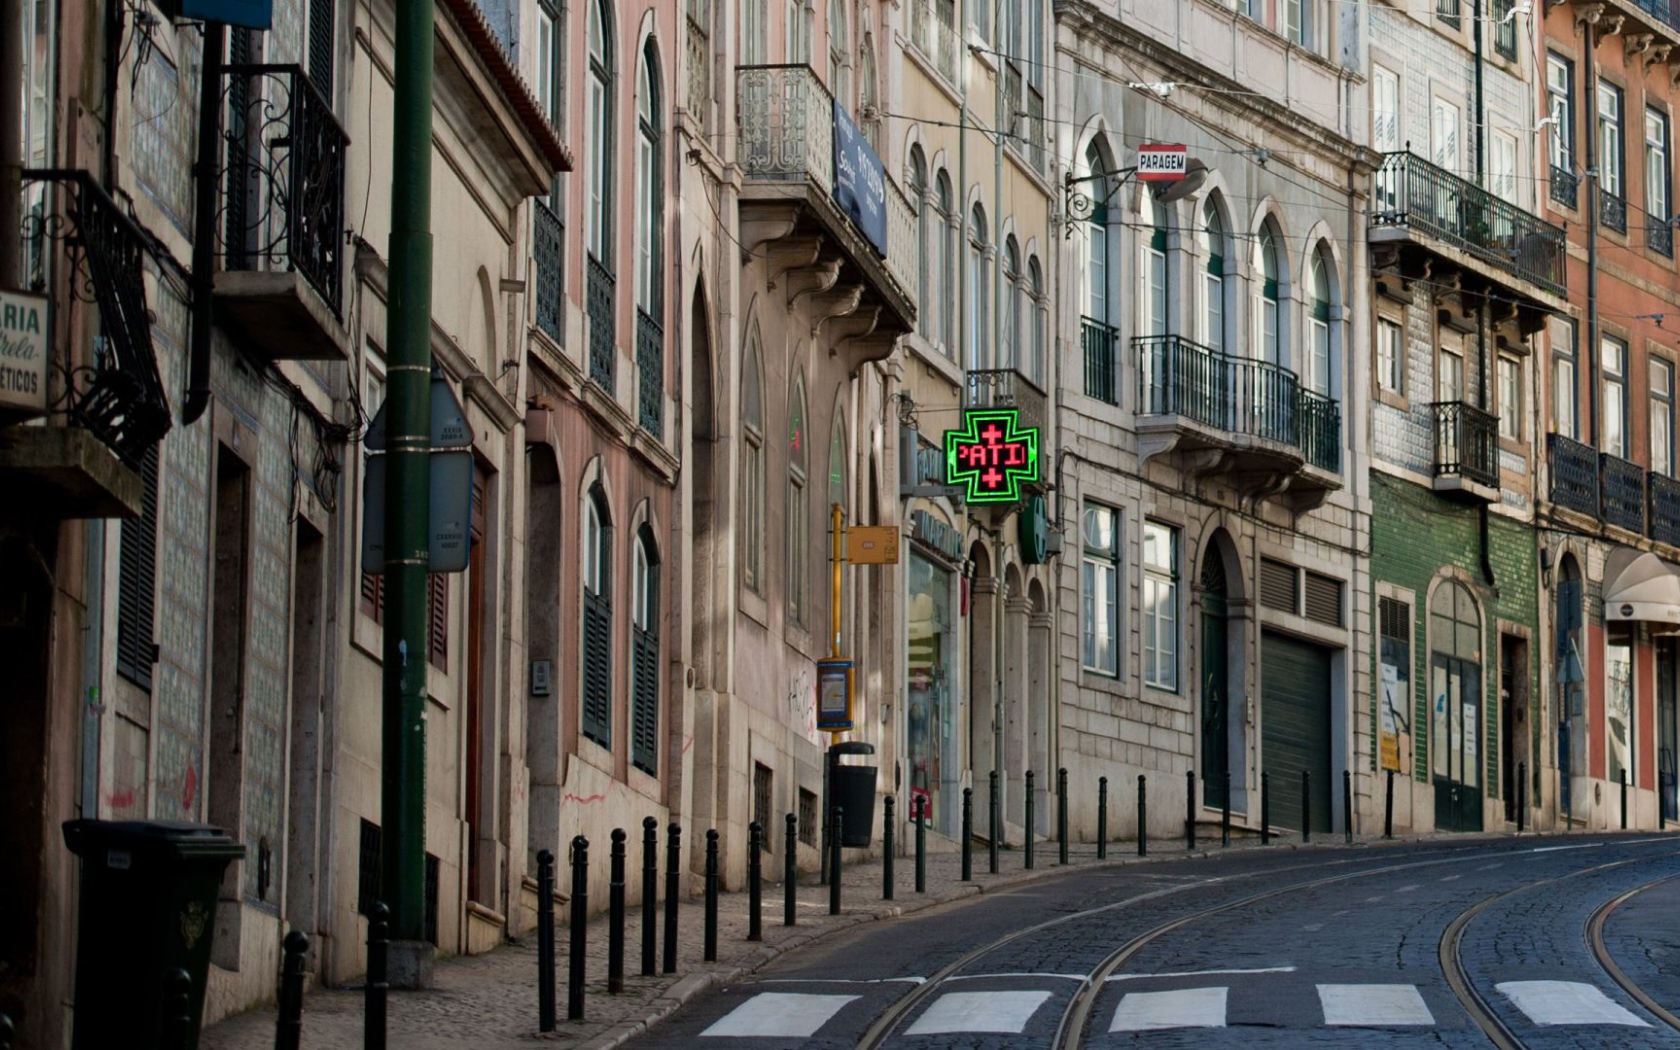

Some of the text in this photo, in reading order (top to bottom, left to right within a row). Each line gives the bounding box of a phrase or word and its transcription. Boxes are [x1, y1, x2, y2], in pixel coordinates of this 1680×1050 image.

[1140, 154, 1184, 170] PARAGEM
[0, 303, 40, 334] RIA
[958, 443, 1025, 466] PATI
